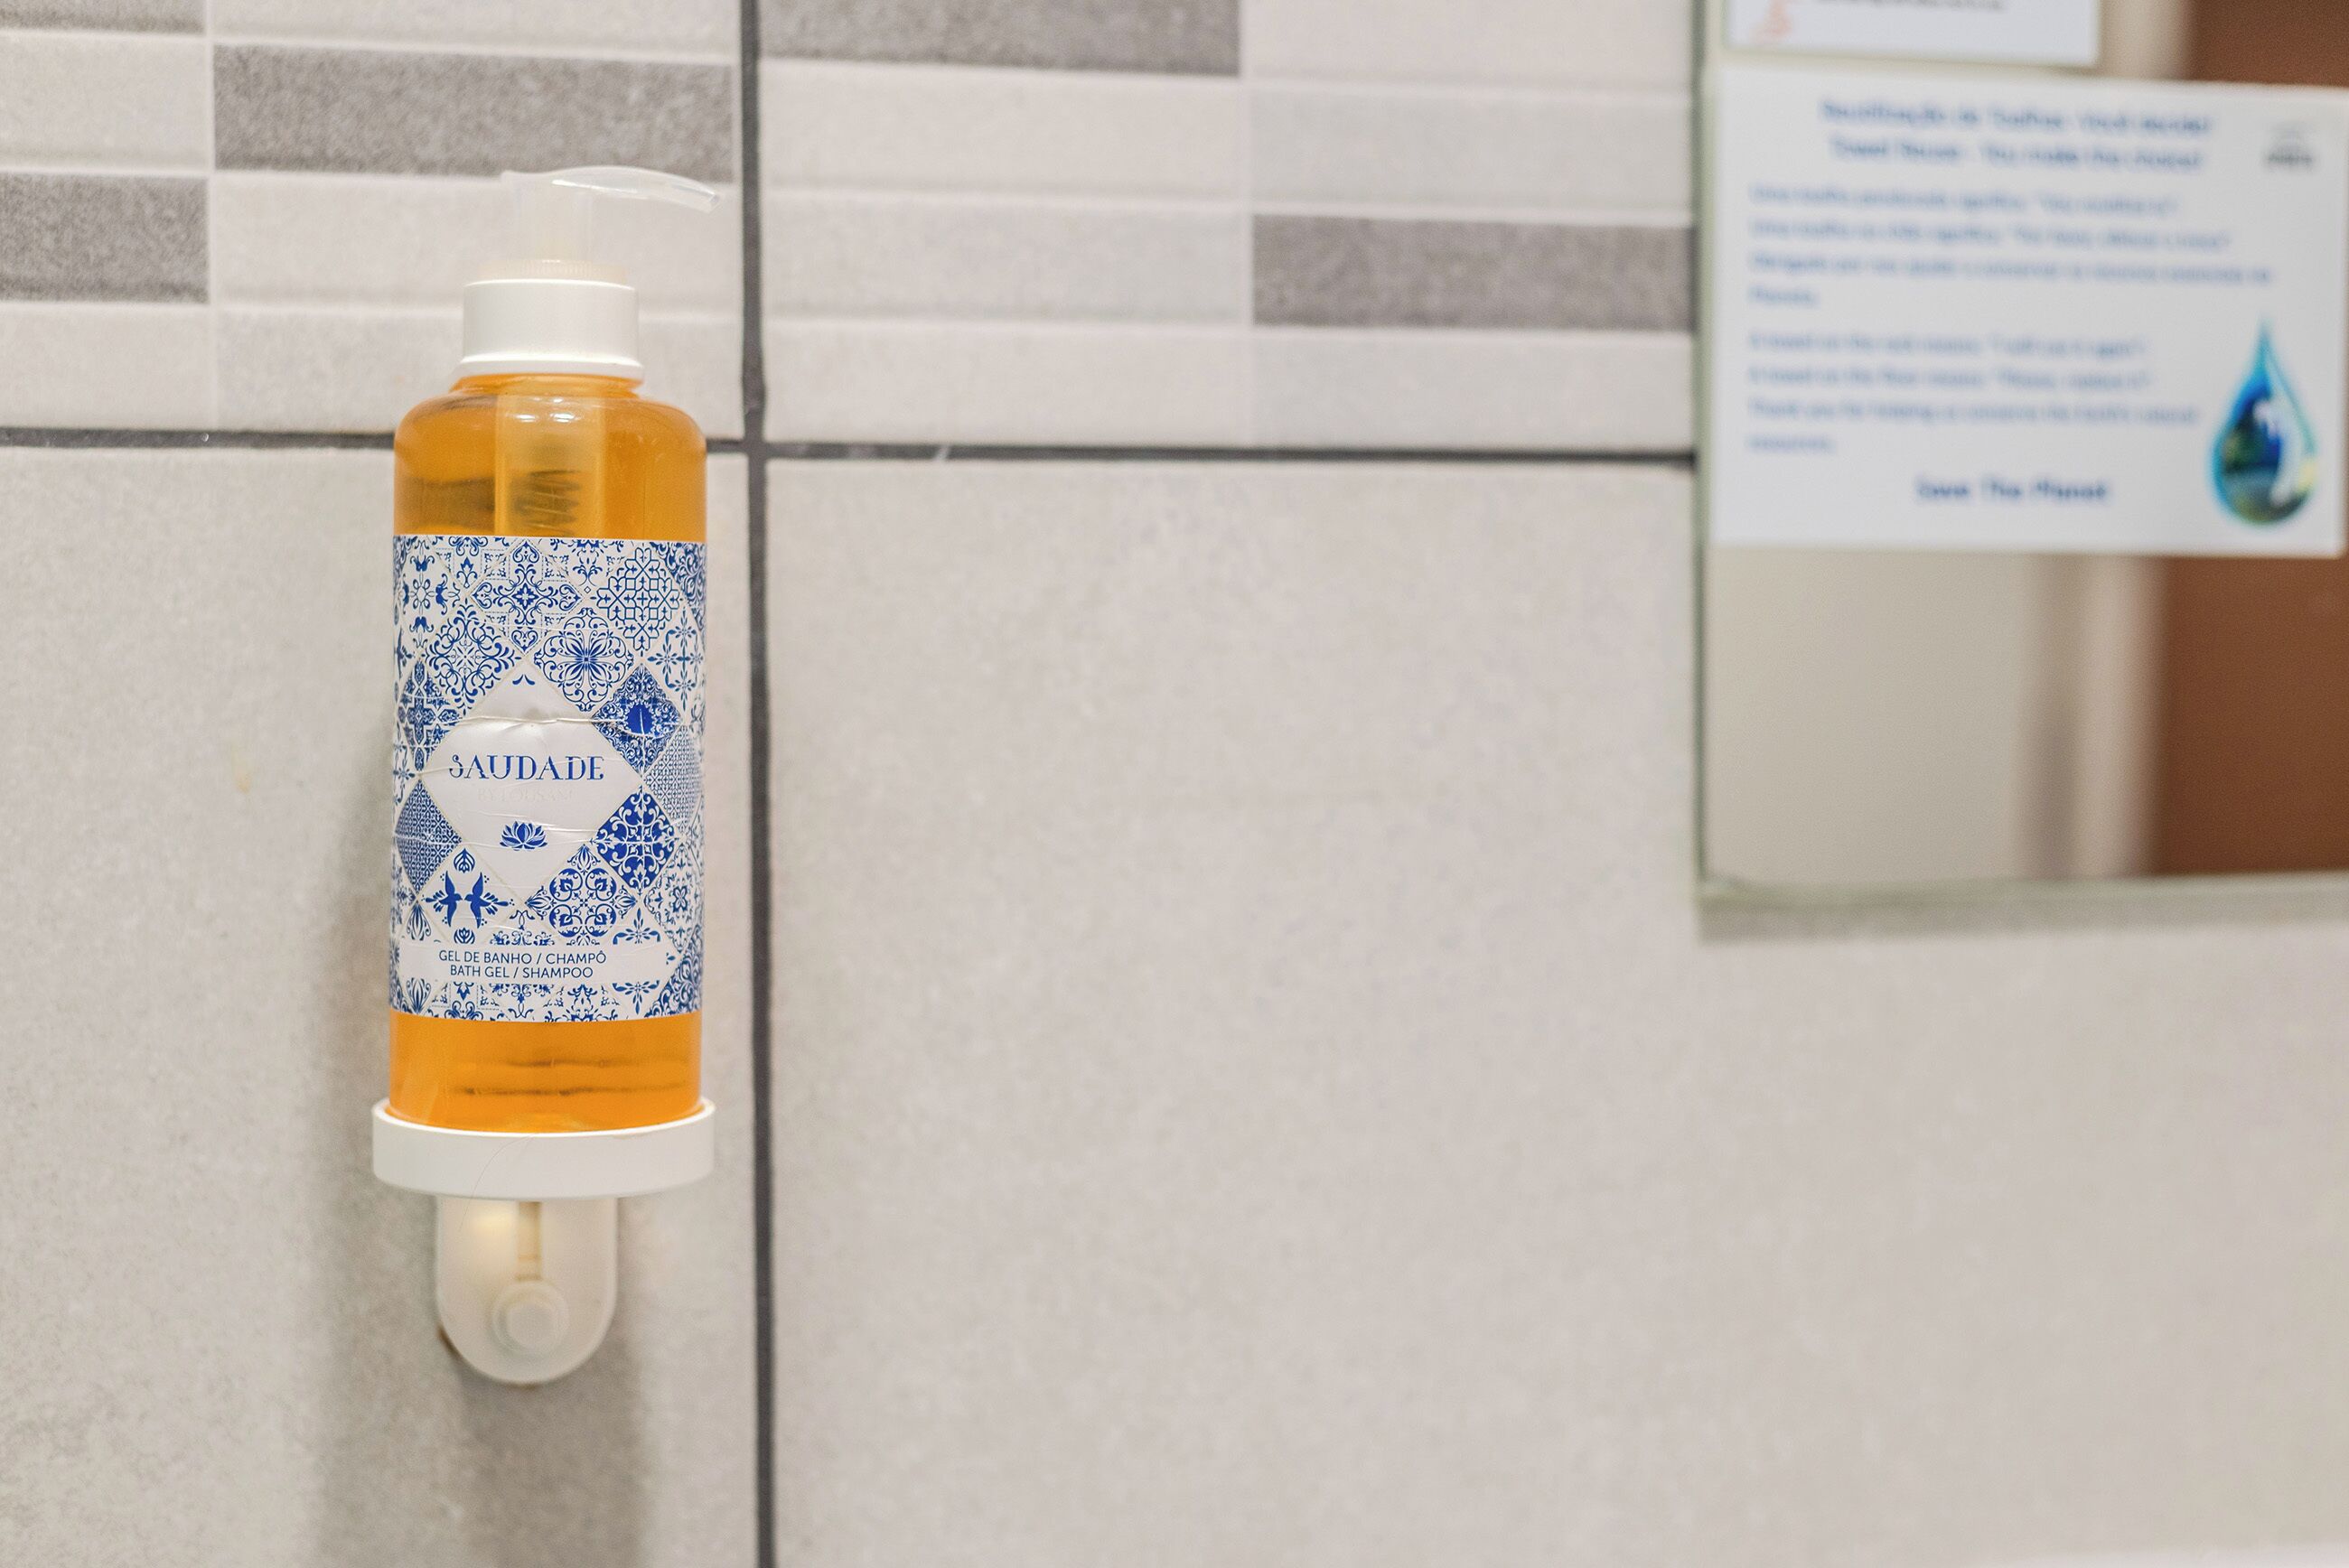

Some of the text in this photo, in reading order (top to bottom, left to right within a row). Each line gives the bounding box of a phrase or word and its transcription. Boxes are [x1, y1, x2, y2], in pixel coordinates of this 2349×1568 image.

[1830, 133, 1892, 159] Towel
[1897, 135, 1965, 163] Reuse
[1983, 141, 2022, 166] You
[2026, 142, 2084, 167] make
[2088, 144, 2126, 169] the
[1912, 476, 2112, 506] Save The Planet
[448, 754, 604, 780] SAUDADE
[439, 950, 461, 962] GEL
[463, 951, 480, 963] DE
[483, 953, 532, 965] BANHO
[546, 950, 607, 965] CHAMPÔ
[450, 965, 481, 977] BATH
[484, 966, 510, 978] GEL
[522, 966, 594, 979] SHAMPOO
